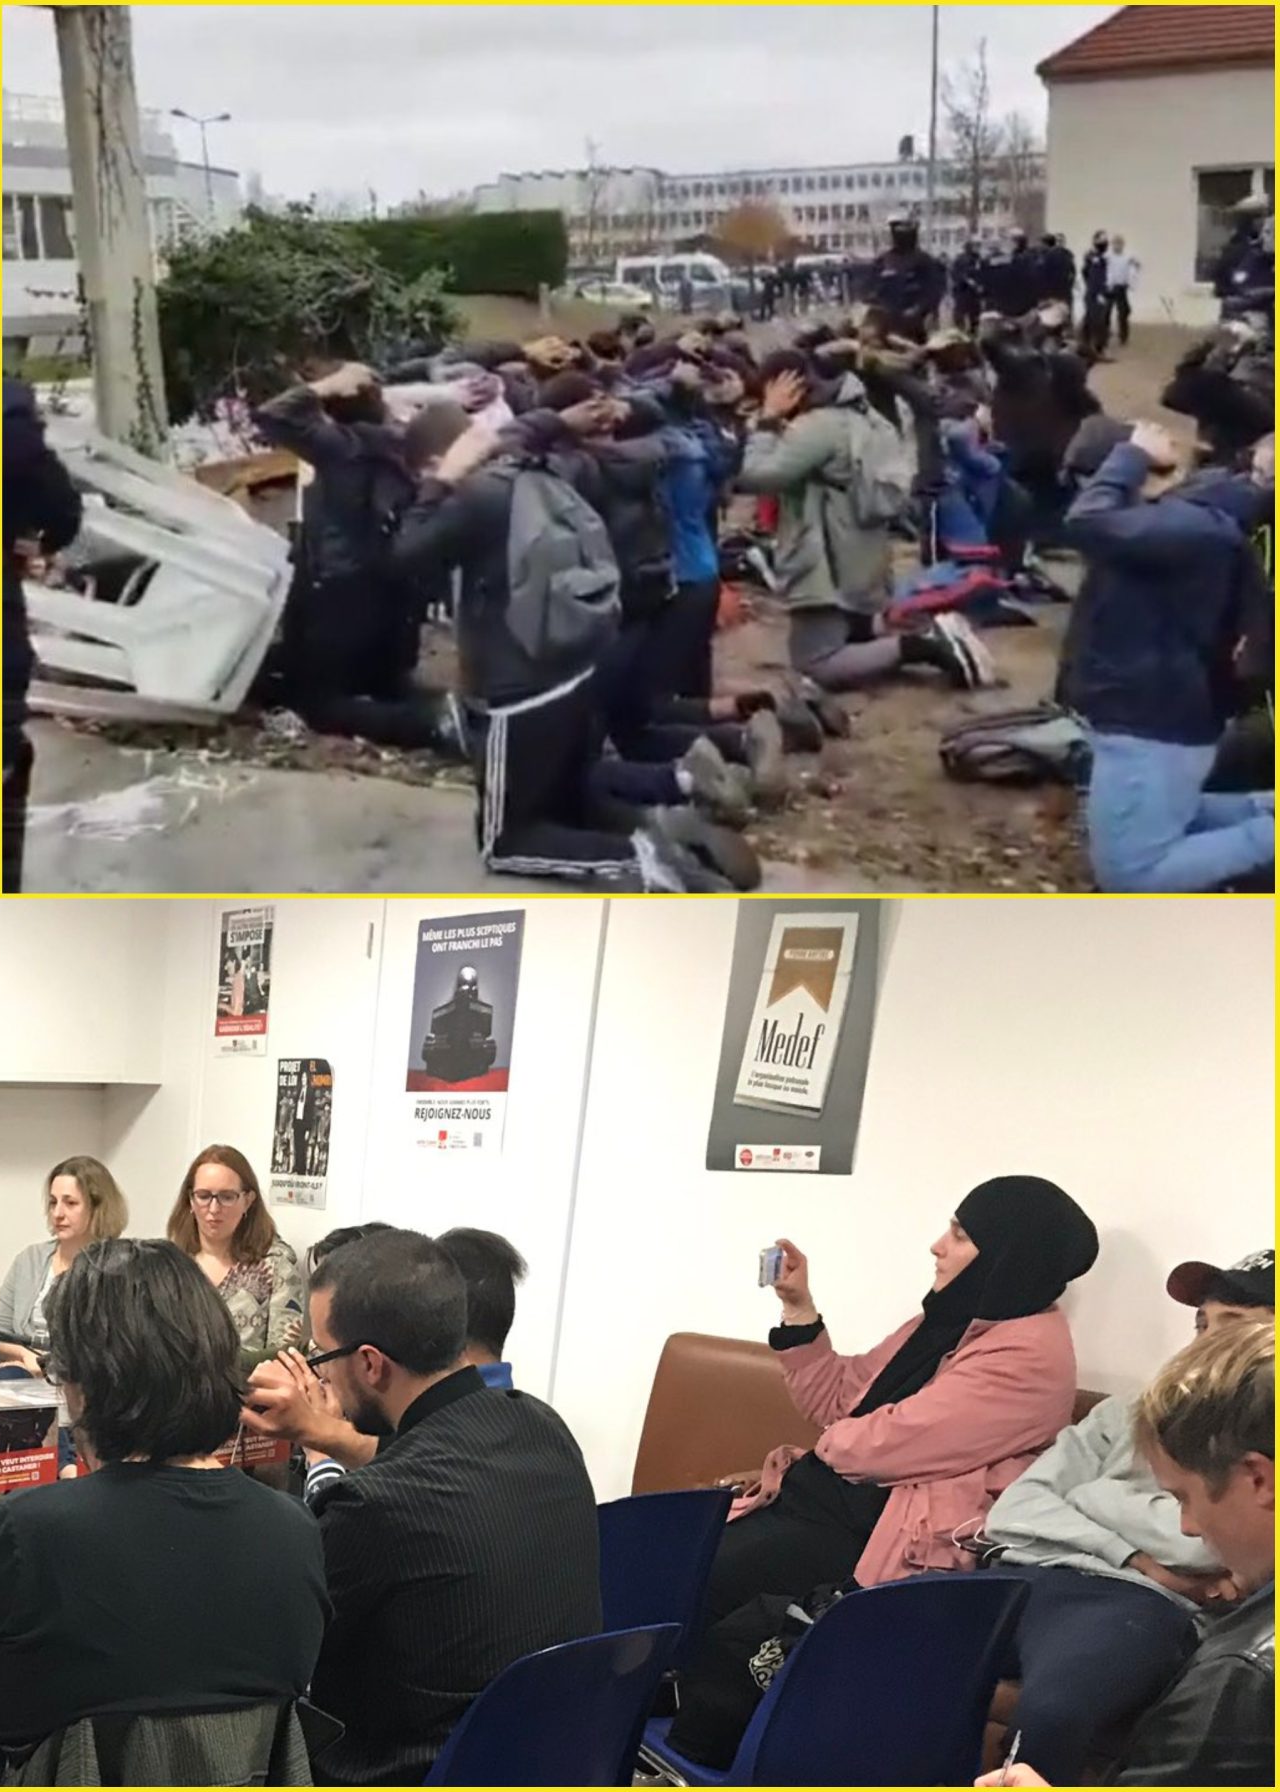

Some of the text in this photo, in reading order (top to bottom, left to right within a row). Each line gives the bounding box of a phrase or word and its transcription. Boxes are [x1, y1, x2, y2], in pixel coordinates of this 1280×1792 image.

[230, 929, 263, 943] S'IMPOSE
[422, 922, 516, 942] MÊME LES PLUS SCEPTIQUES
[431, 937, 503, 953] ONT FRANCHI LE PAS
[754, 1012, 825, 1070] Medef
[280, 1060, 301, 1074] PROJET
[279, 1075, 287, 1086] DE
[288, 1074, 298, 1086] LOI
[414, 1107, 491, 1122] REJOIGNEZ-NOUS
[245, 1440, 274, 1450] ASTANER
[0, 1457, 19, 1466] VEUT
[19, 1453, 55, 1463] INTERDIRE
[2, 1463, 37, 1474] CASTANER
